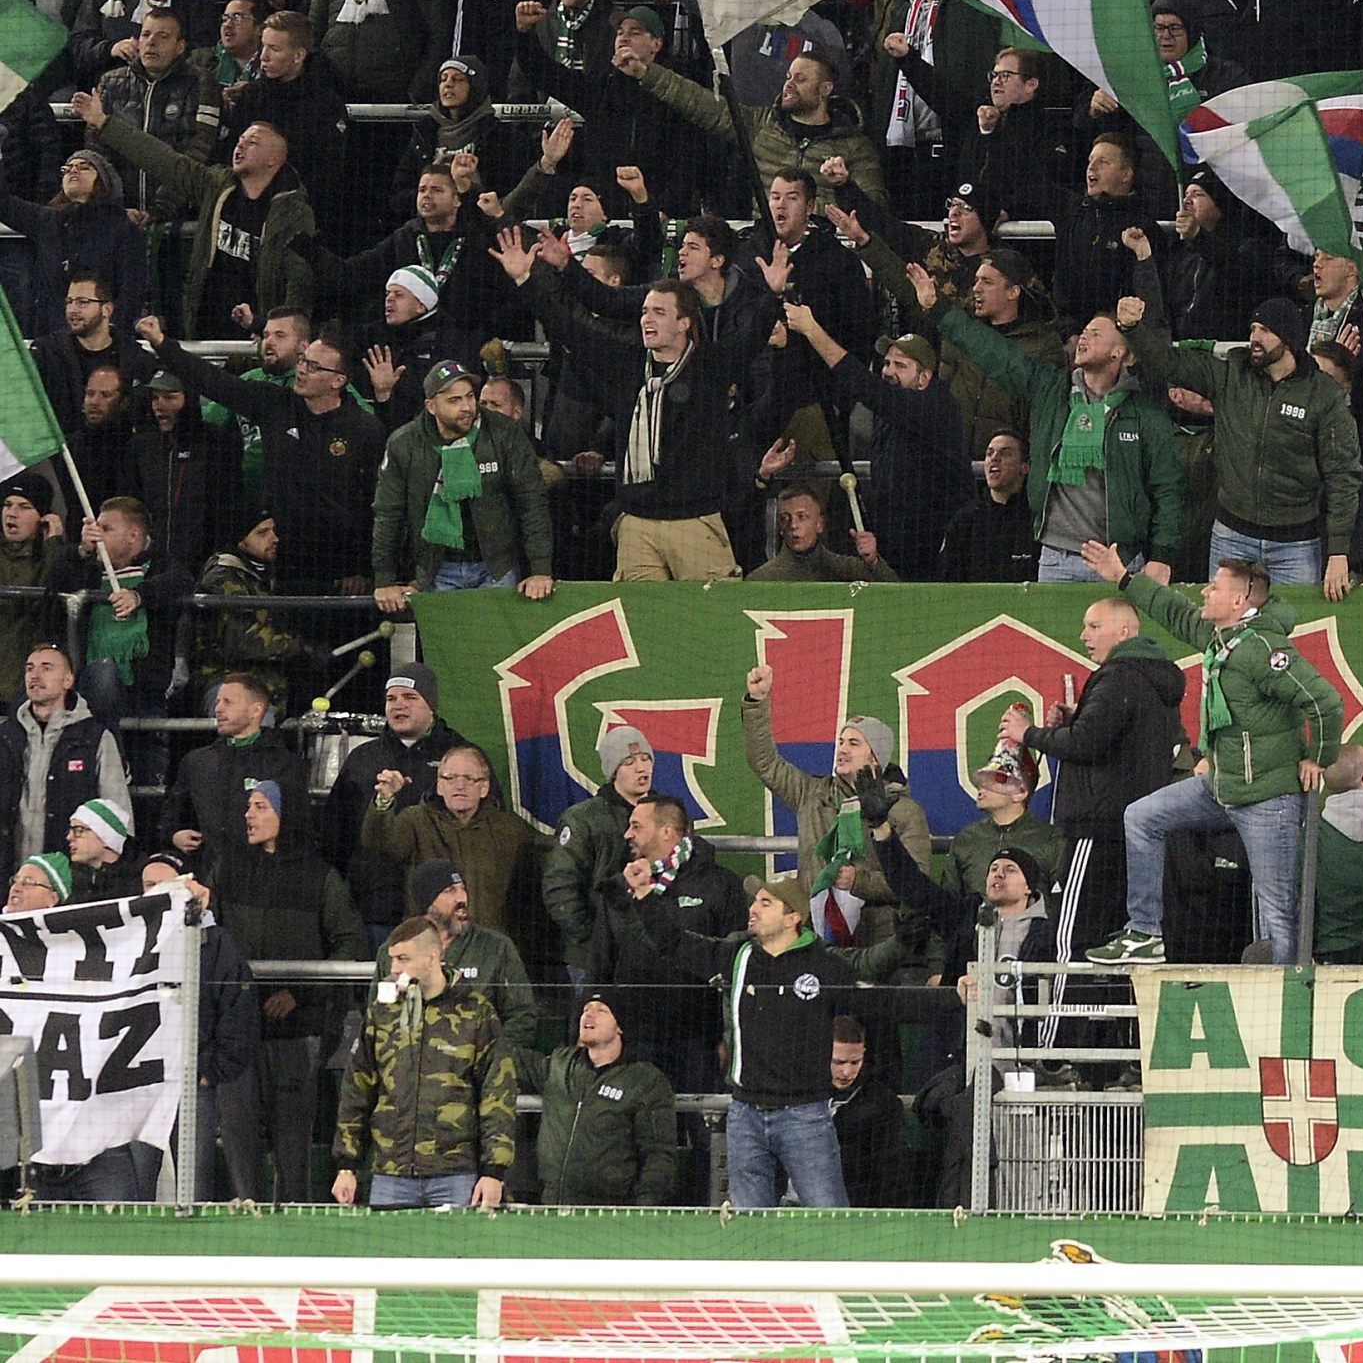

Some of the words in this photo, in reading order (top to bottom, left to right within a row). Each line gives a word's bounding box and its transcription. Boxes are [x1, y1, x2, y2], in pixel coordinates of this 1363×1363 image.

[1280, 402, 1306, 419] 1988
[478, 461, 499, 475] 988
[597, 1084, 624, 1101] 1988
